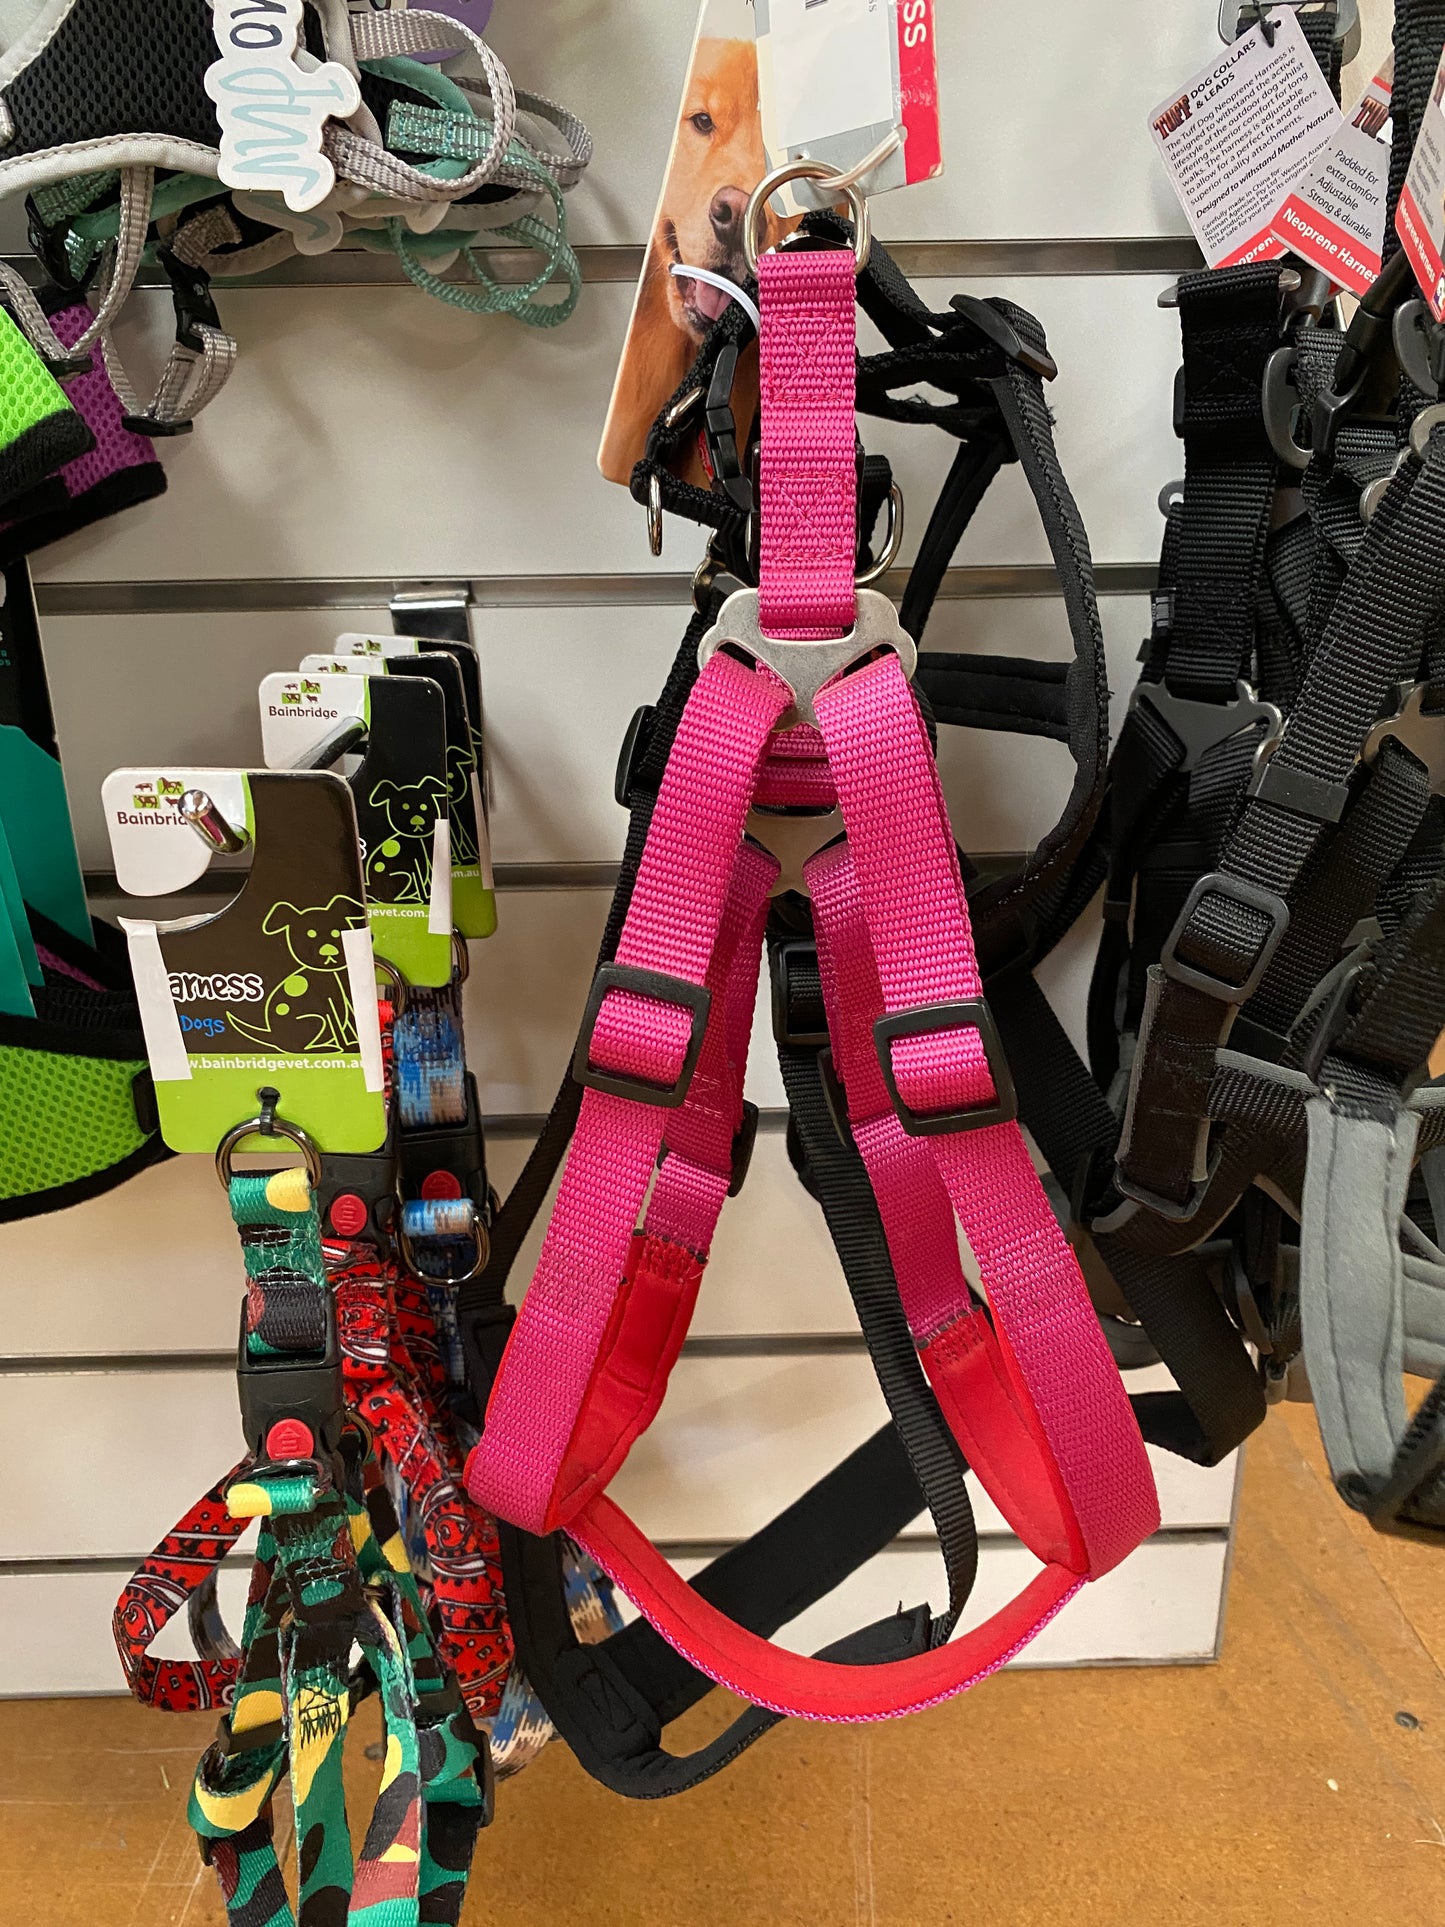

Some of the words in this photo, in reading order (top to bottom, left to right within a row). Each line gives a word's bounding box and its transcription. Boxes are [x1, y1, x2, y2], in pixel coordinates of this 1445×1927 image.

[1189, 76, 1212, 100] DOG
[1213, 39, 1256, 79] COLLARS
[1195, 100, 1204, 110] &
[1203, 71, 1235, 102] LEADS
[1152, 95, 1194, 140] TUFF
[1165, 138, 1181, 151] The
[1179, 122, 1196, 139] Tuff
[1196, 110, 1214, 128] Dog
[1214, 79, 1256, 113] Neoprene
[1253, 51, 1287, 80] Harness
[1287, 44, 1295, 53] is
[1168, 128, 1205, 161] designed
[1215, 88, 1255, 124] withstand
[1255, 77, 1270, 91] the
[1271, 56, 1295, 79] active
[1173, 143, 1203, 170] lifestyle
[1212, 124, 1227, 138] the
[1228, 96, 1260, 126] outdoor
[1261, 83, 1278, 99] dog
[1278, 61, 1304, 84] whilst
[1178, 151, 1209, 178] offering
[1209, 124, 1241, 154] superior
[1242, 97, 1275, 127] comfort
[1274, 87, 1286, 101] for
[1287, 71, 1308, 90] long
[1195, 169, 1216, 189] allow
[1216, 158, 1228, 171] for
[1235, 130, 1265, 158] perfect
[1264, 121, 1275, 133] fit
[1275, 107, 1292, 125] and
[1292, 89, 1317, 111] offers
[1204, 153, 1221, 167] The
[1220, 128, 1252, 156] harness
[1260, 87, 1303, 124] adjustable
[1190, 177, 1221, 206] superior
[1222, 154, 1249, 179] quality
[1195, 186, 1230, 219] Designed
[1238, 149, 1277, 184] withstand
[1274, 128, 1305, 155] Mother
[1305, 106, 1334, 132] Nature
[1325, 164, 1346, 182] extra
[1346, 179, 1379, 205] comfort
[1334, 149, 1368, 176] Padded
[1364, 170, 1379, 184] for
[1201, 207, 1227, 231] Carefully
[1227, 195, 1245, 211] made
[1252, 176, 1270, 191] China
[1306, 188, 1334, 214] Strong
[1333, 207, 1342, 218] &
[1340, 213, 1371, 239] durable
[1315, 176, 1358, 210] Adjustable
[1282, 207, 1337, 254] Neoprene
[1336, 247, 1378, 283] Harnes
[269, 706, 338, 720] Bainbridge
[167, 973, 264, 1003] arness
[180, 1015, 225, 1037] Dogs
